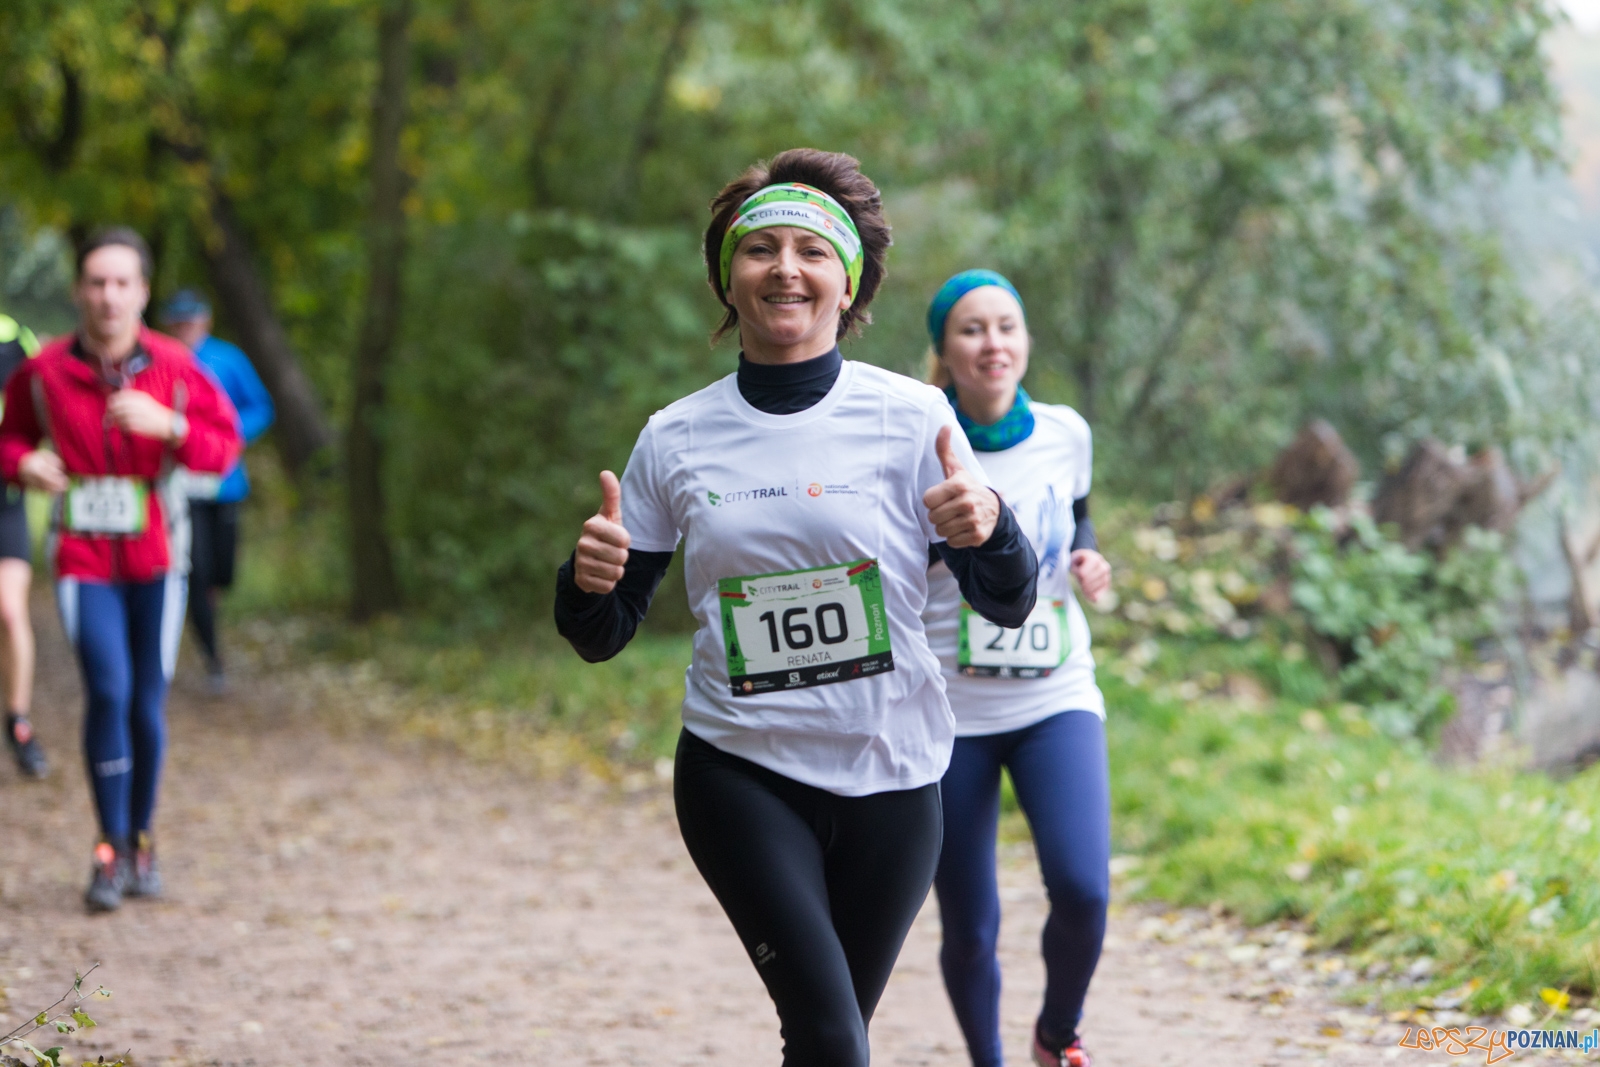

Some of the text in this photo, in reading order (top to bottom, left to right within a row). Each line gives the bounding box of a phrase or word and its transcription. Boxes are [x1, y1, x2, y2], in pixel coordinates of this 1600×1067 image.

[759, 602, 849, 653] 160
[869, 603, 884, 641] Poznań
[984, 622, 1049, 651] 270
[787, 651, 832, 667] RENATA
